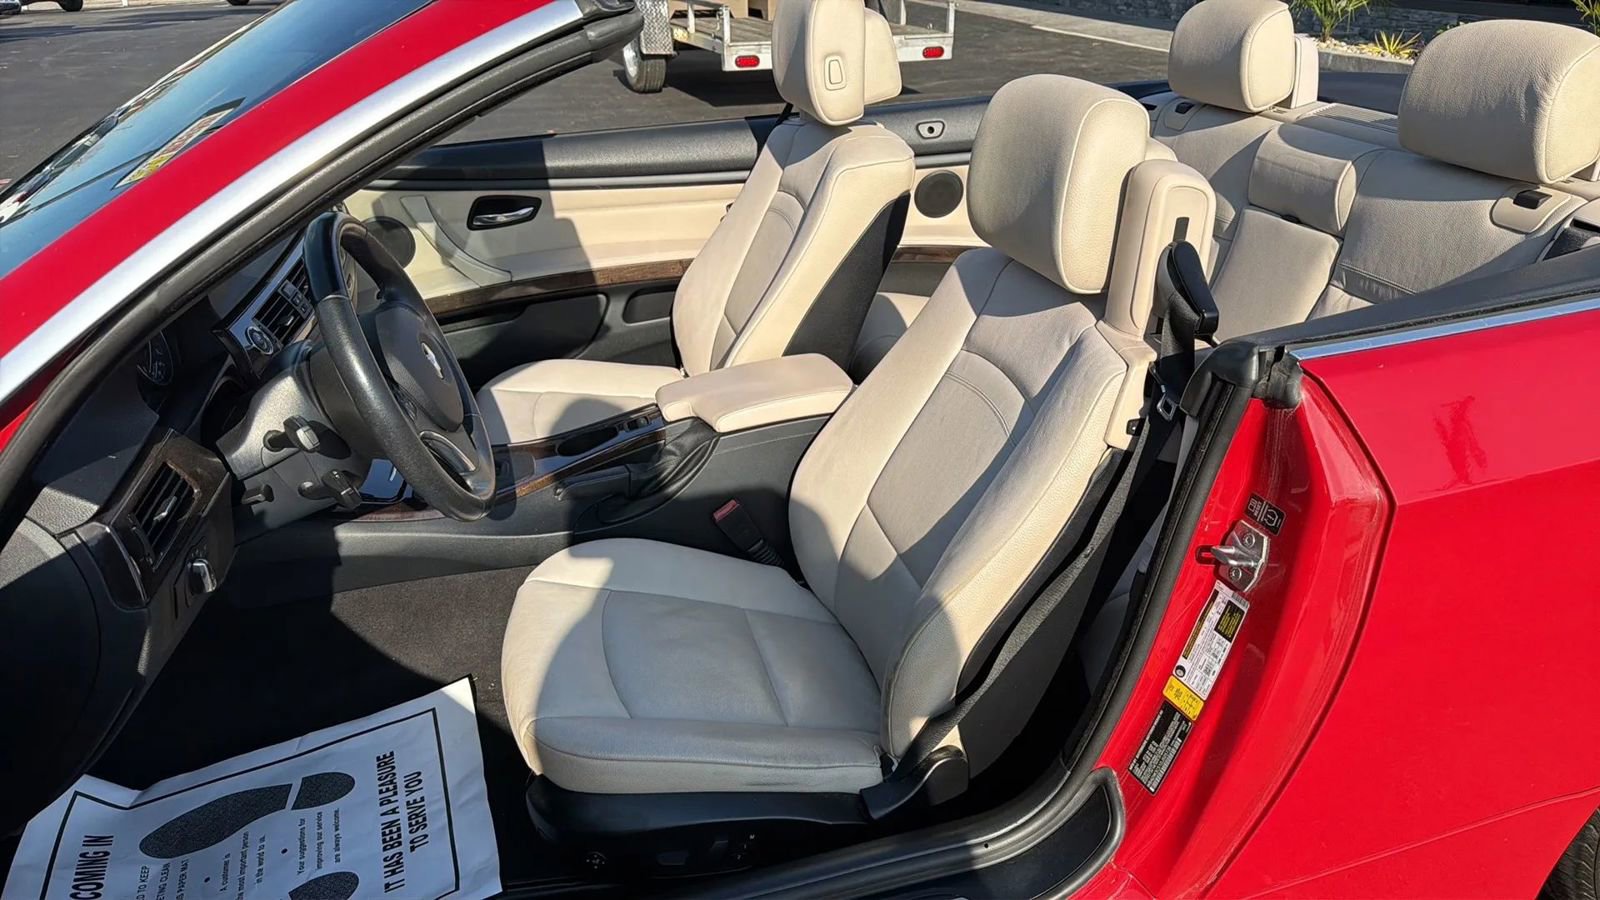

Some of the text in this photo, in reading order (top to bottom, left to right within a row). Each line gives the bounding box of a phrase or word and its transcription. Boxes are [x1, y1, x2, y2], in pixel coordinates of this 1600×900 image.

[376, 751, 405, 893] IT HAS BEEN A PLEASURE
[404, 771, 429, 853] TO SERVE YOU
[241, 831, 249, 849] person
[297, 818, 307, 875] Your suggestions for
[333, 833, 342, 852] always
[180, 859, 189, 872] MAT
[239, 850, 247, 876] important
[257, 851, 265, 867] world
[315, 841, 324, 870] improving
[69, 835, 114, 900] COMING IN
[140, 866, 150, 882] KEEP
[160, 863, 170, 882] CLEAN
[222, 859, 230, 886] customer
[137, 884, 147, 894] TO
[177, 872, 187, 893] PAPER
[238, 876, 246, 891] most
